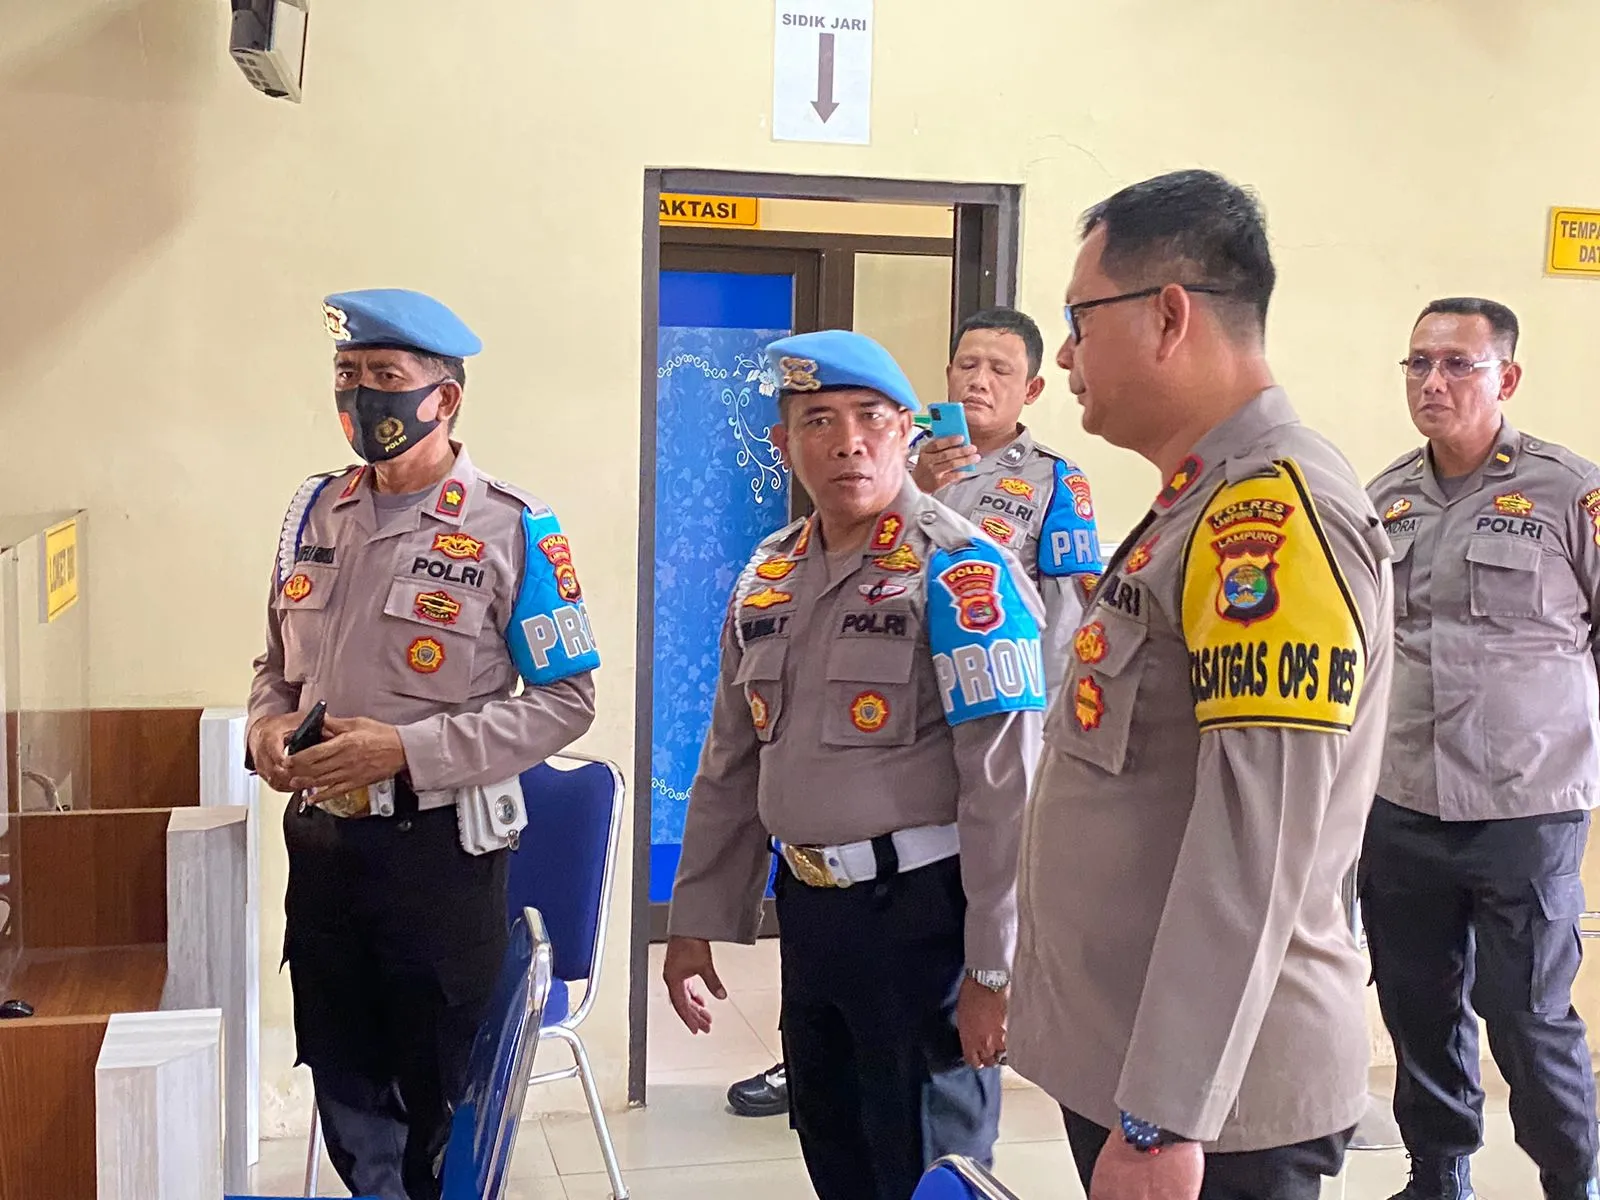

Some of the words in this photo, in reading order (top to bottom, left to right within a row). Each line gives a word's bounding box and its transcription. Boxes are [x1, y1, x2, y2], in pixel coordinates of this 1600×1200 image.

[782, 13, 826, 29] SIDIK
[831, 17, 867, 31] JARI
[659, 199, 737, 219] AKTASI
[384, 434, 408, 453] POLRI
[979, 495, 1034, 522] POLRI
[1217, 531, 1278, 549] LAMPUNG
[1476, 517, 1544, 540] POLRI
[411, 556, 485, 588] POLRI
[947, 565, 993, 582] POLDA
[841, 613, 907, 637] POLRI
[932, 638, 1044, 713] PROV
[1278, 641, 1320, 701] OPS
[1327, 646, 1357, 706] RES
